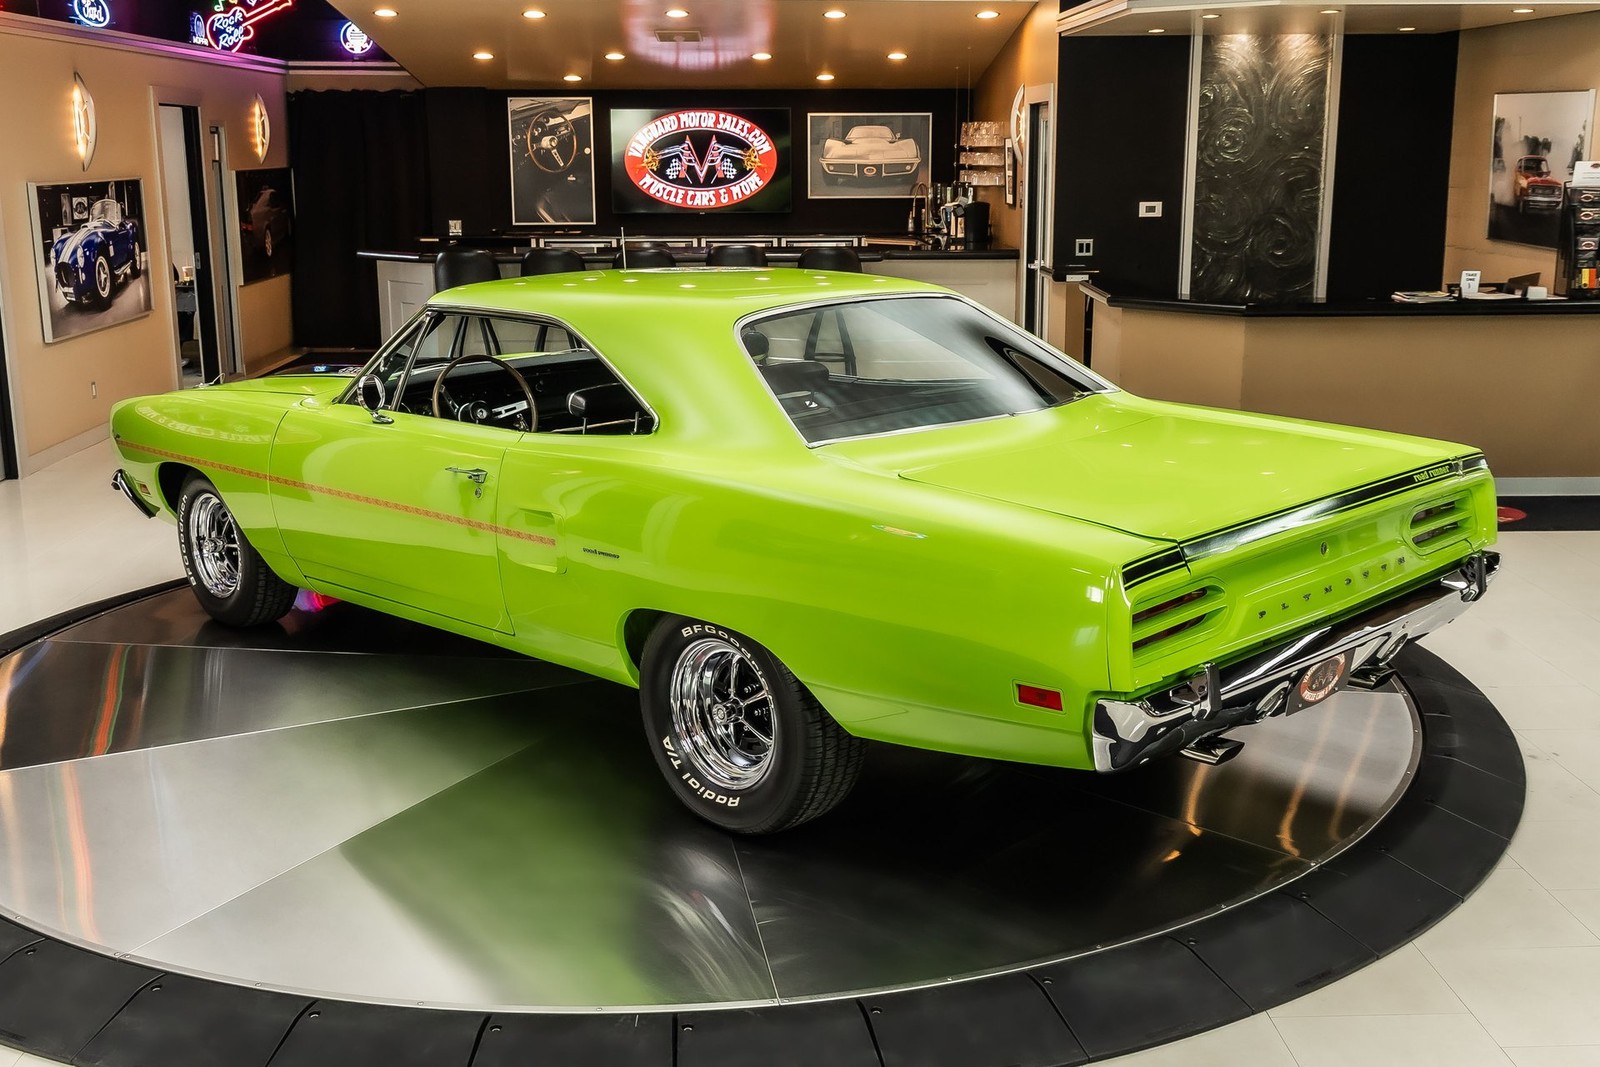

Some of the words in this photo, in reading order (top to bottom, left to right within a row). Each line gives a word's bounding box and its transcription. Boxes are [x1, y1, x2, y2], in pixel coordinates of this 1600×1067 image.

[213, 9, 243, 31] Rock
[219, 26, 244, 49] Roll
[628, 115, 678, 158] VANGUARD
[679, 112, 716, 128] MOTOR
[717, 113, 772, 155] SALES.COM
[638, 174, 685, 205] MUSCLE
[686, 190, 716, 206] CARS
[719, 189, 728, 204] &
[730, 172, 764, 201] MORE
[1413, 470, 1430, 483] road
[1258, 556, 1406, 619] PLYMOUTH
[662, 735, 681, 770] T/A
[682, 772, 740, 807] Radial
